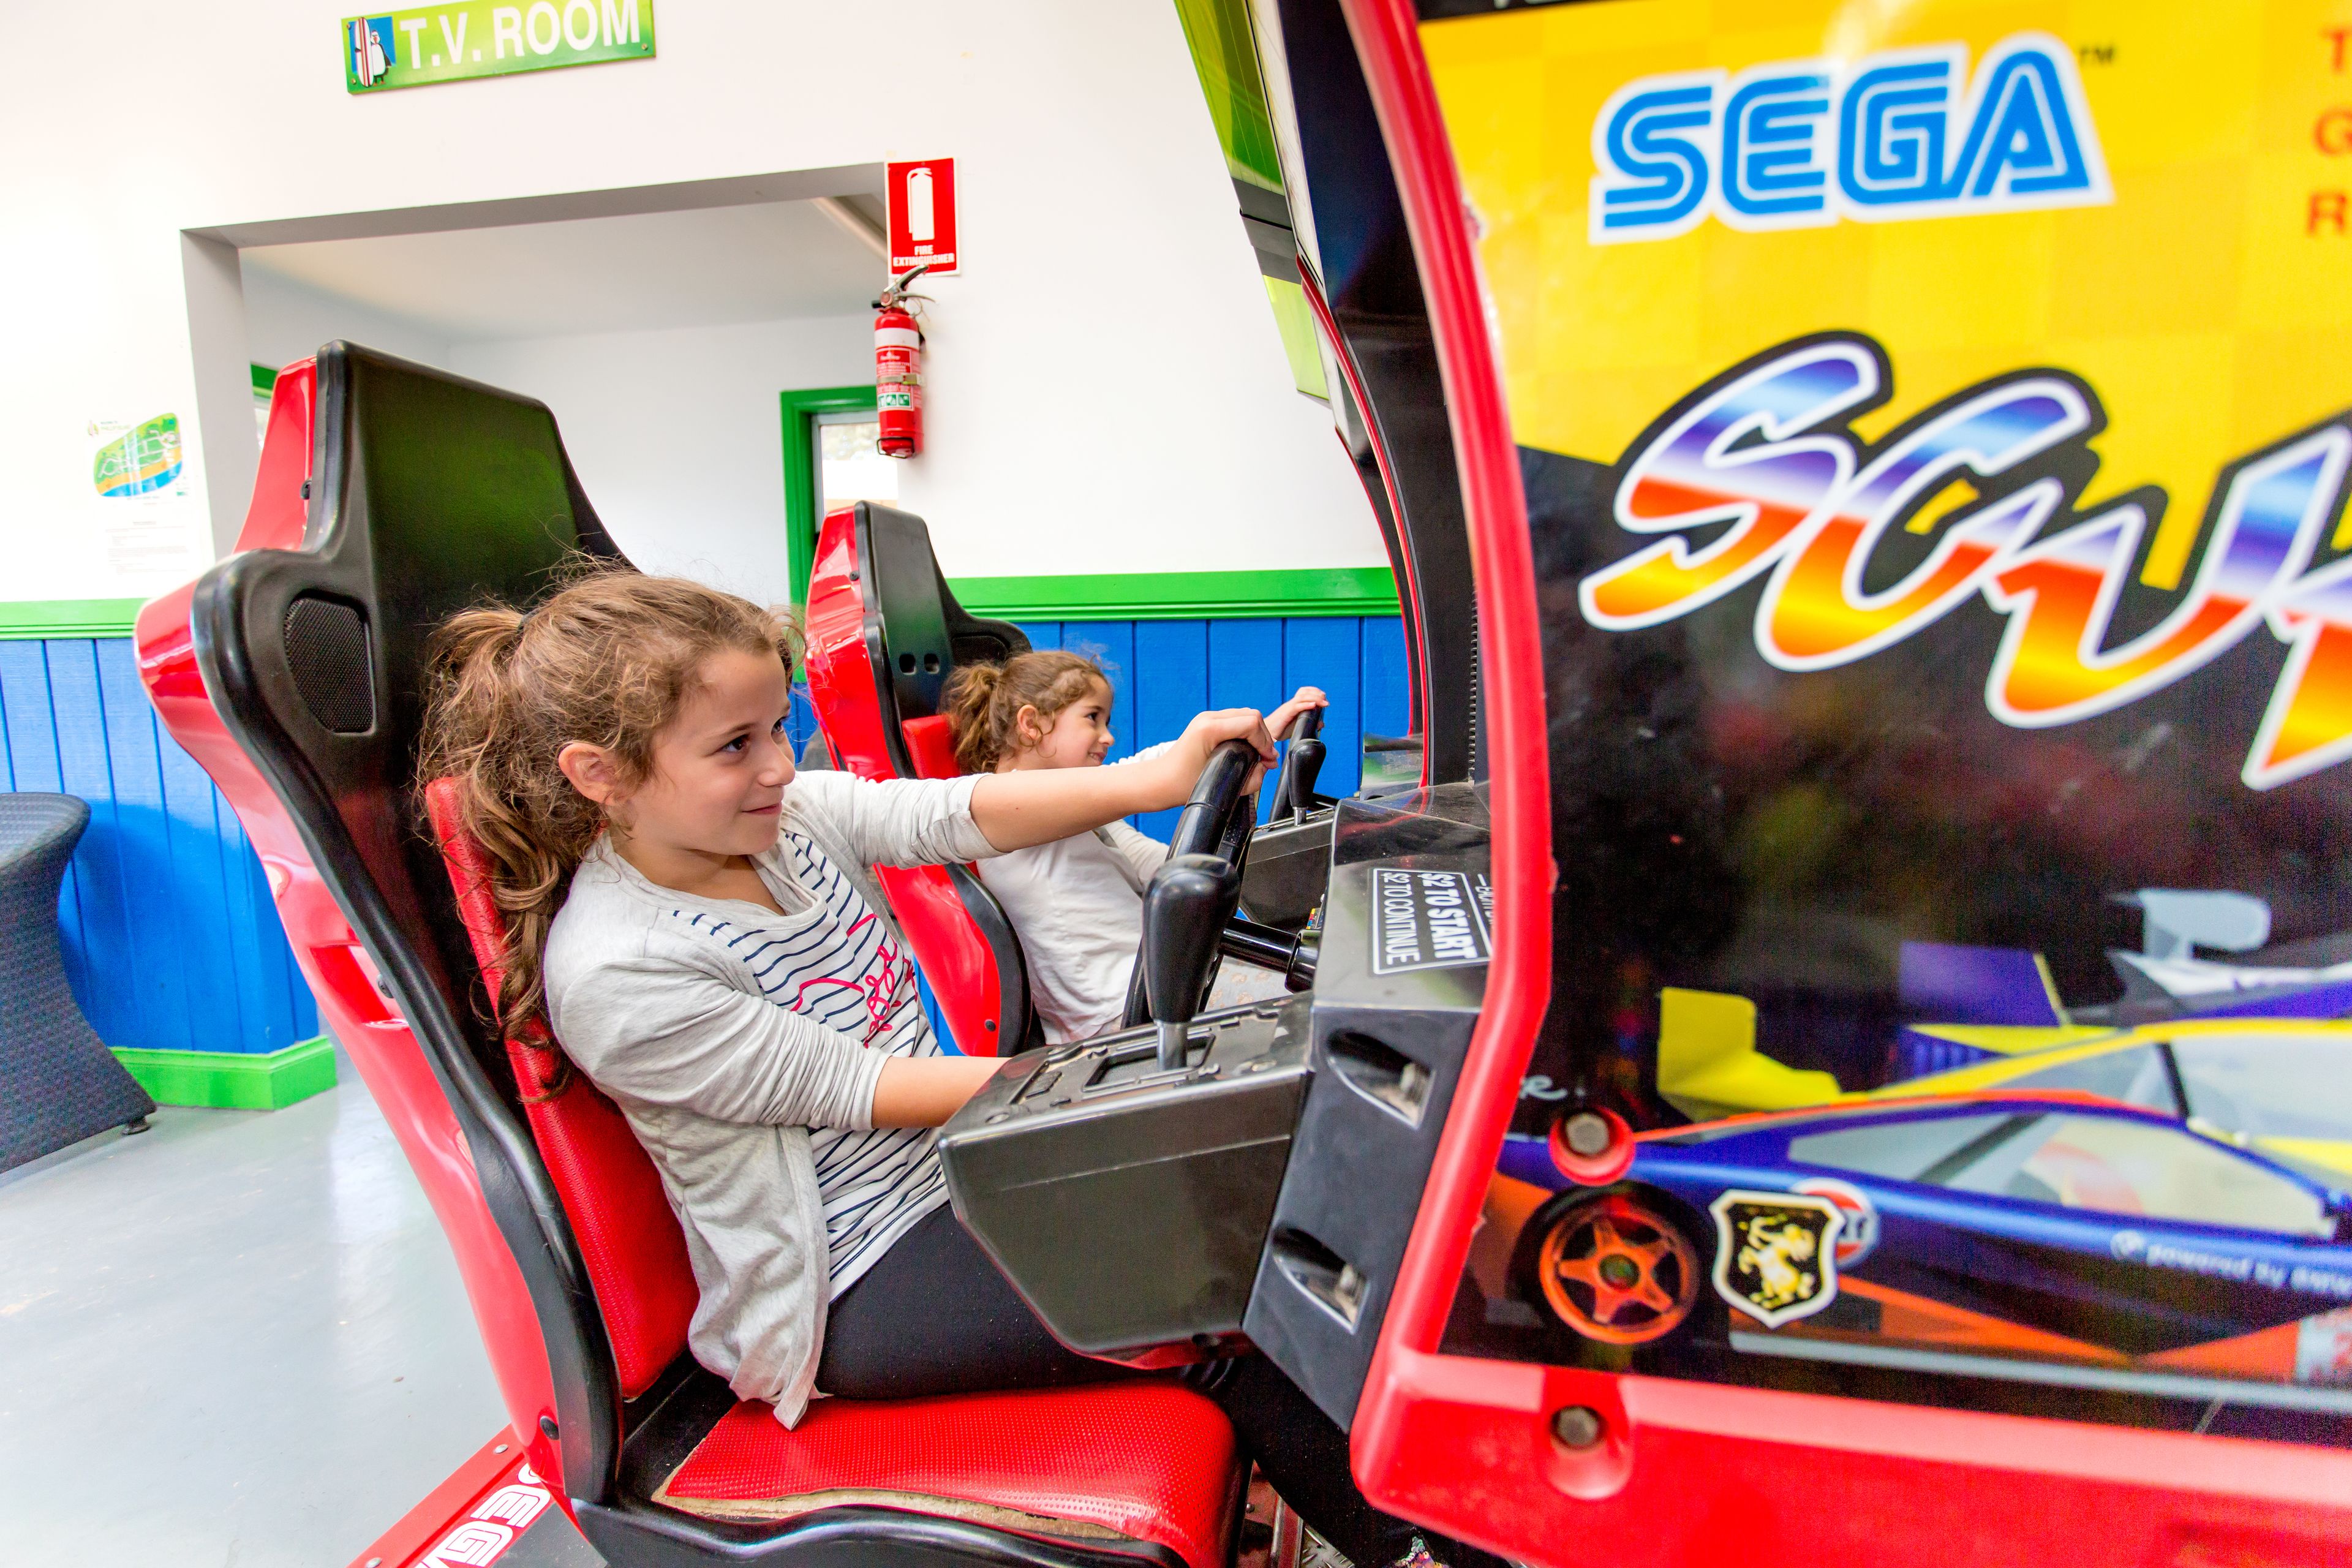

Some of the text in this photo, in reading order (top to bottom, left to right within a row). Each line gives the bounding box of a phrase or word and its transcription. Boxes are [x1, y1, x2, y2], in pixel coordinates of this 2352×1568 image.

[399, 0, 641, 69] T.V. ROOM
[1593, 37, 2107, 240] SEGA
[892, 252, 955, 266] EXTINGUISHER
[914, 244, 934, 256] FIRE
[1381, 872, 1421, 965] $2 TO CONTINUE
[1417, 872, 1478, 959] $2 TO START
[414, 1463, 551, 1568] EG
